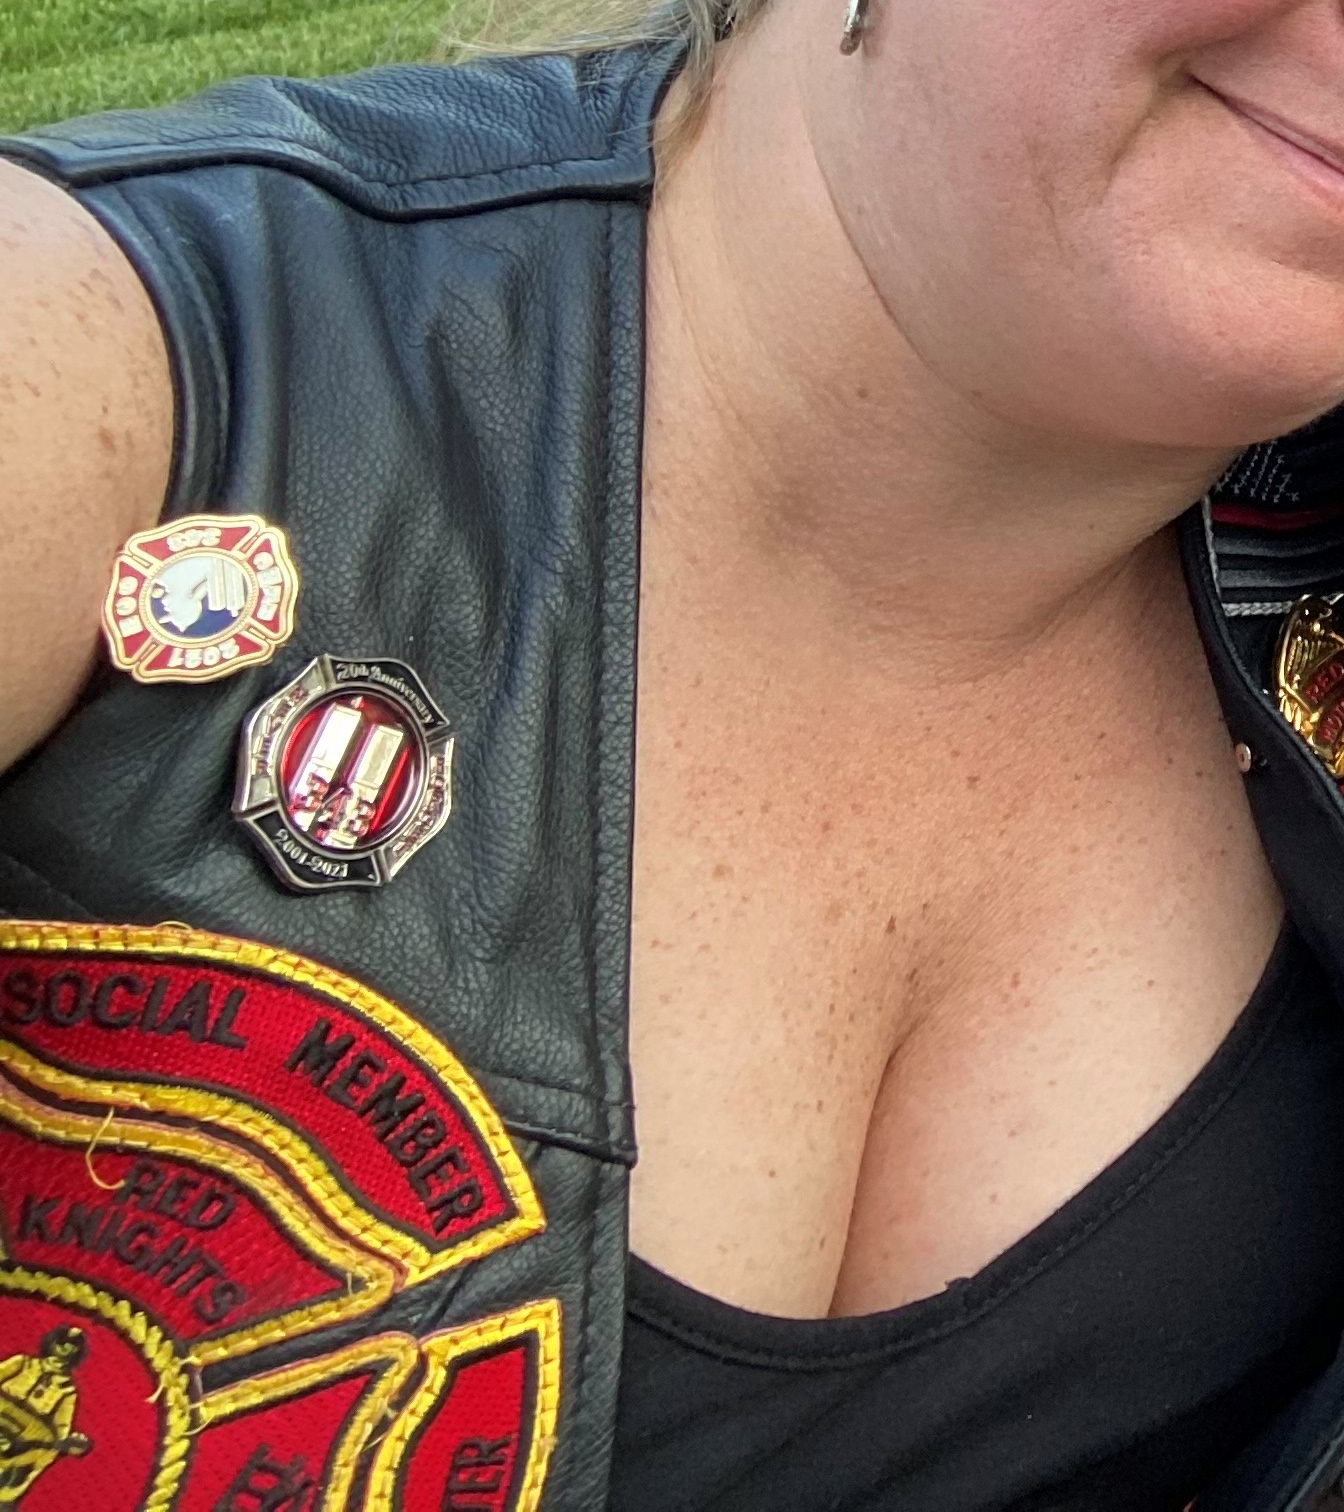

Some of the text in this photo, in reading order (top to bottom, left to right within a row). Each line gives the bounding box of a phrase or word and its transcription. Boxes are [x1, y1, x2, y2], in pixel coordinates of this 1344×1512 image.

[272, 828, 350, 880] 2001-2021
[1, 968, 484, 1236] SOCIAL MEMBER
[114, 1157, 235, 1231] RED
[18, 1193, 246, 1324] KNIGHTS
